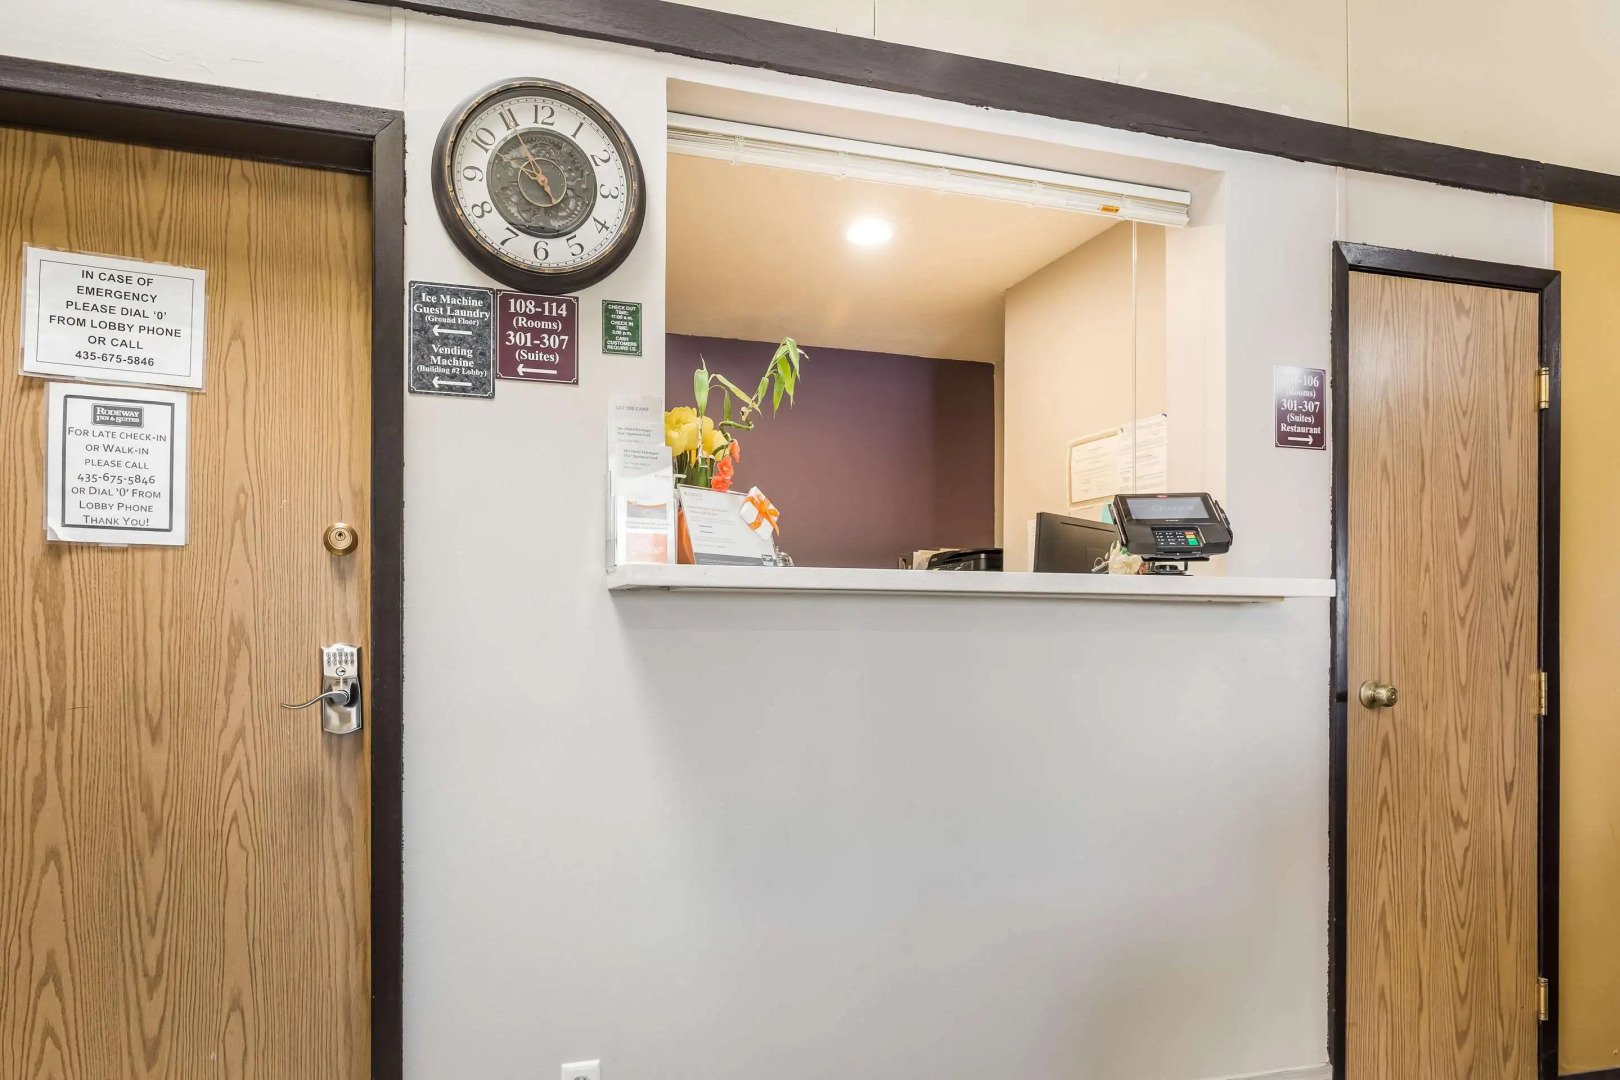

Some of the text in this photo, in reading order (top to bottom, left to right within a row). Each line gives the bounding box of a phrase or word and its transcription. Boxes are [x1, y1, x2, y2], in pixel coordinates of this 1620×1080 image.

[498, 108, 520, 131] 11
[533, 104, 555, 126] 12
[570, 121, 584, 140] 1
[471, 127, 496, 155] 10
[590, 149, 611, 168] 2
[462, 165, 484, 182] 9
[599, 183, 619, 200] 3
[471, 201, 493, 219] 8
[592, 215, 610, 234] 4
[499, 226, 520, 247] 7
[533, 240, 549, 261] 6
[565, 234, 585, 257] 5
[81, 269, 154, 287] IN CASE OF
[76, 285, 158, 303] EMERGENCY
[421, 292, 484, 307] Ice Machine
[66, 300, 116, 315] PLEASE
[120, 307, 150, 319] DIAL
[414, 303, 490, 321] Guest Laundry
[508, 298, 568, 318] 108-114
[49, 315, 182, 338] FROM LOBBY PHONE
[425, 314, 480, 327] (Ground Floor)
[513, 316, 562, 333] (Rooms)
[87, 335, 144, 350] OR CALL
[505, 330, 569, 350] 301-307
[75, 350, 155, 367] 435-675-5846
[432, 344, 473, 358] Vending
[515, 348, 560, 365] (Suites)
[430, 355, 475, 368] Machine
[416, 364, 487, 377] (Building #2 Lobby)
[96, 406, 140, 417] RODEWAY
[1280, 398, 1320, 413] 301-307
[1286, 412, 1315, 425] (Suites)
[67, 426, 167, 442] FOR LATE CHECK-IN
[1280, 422, 1321, 434] Restaurant
[85, 443, 149, 455] OR WALK-IN
[84, 458, 150, 470] PLEASE CALL
[77, 472, 156, 486] 435-675-5846
[71, 486, 85, 495] OR
[88, 486, 114, 497] DIAL
[131, 488, 161, 499] FROM
[79, 500, 154, 513] LOBBY PHONE
[83, 514, 150, 527] THANK YOU!
